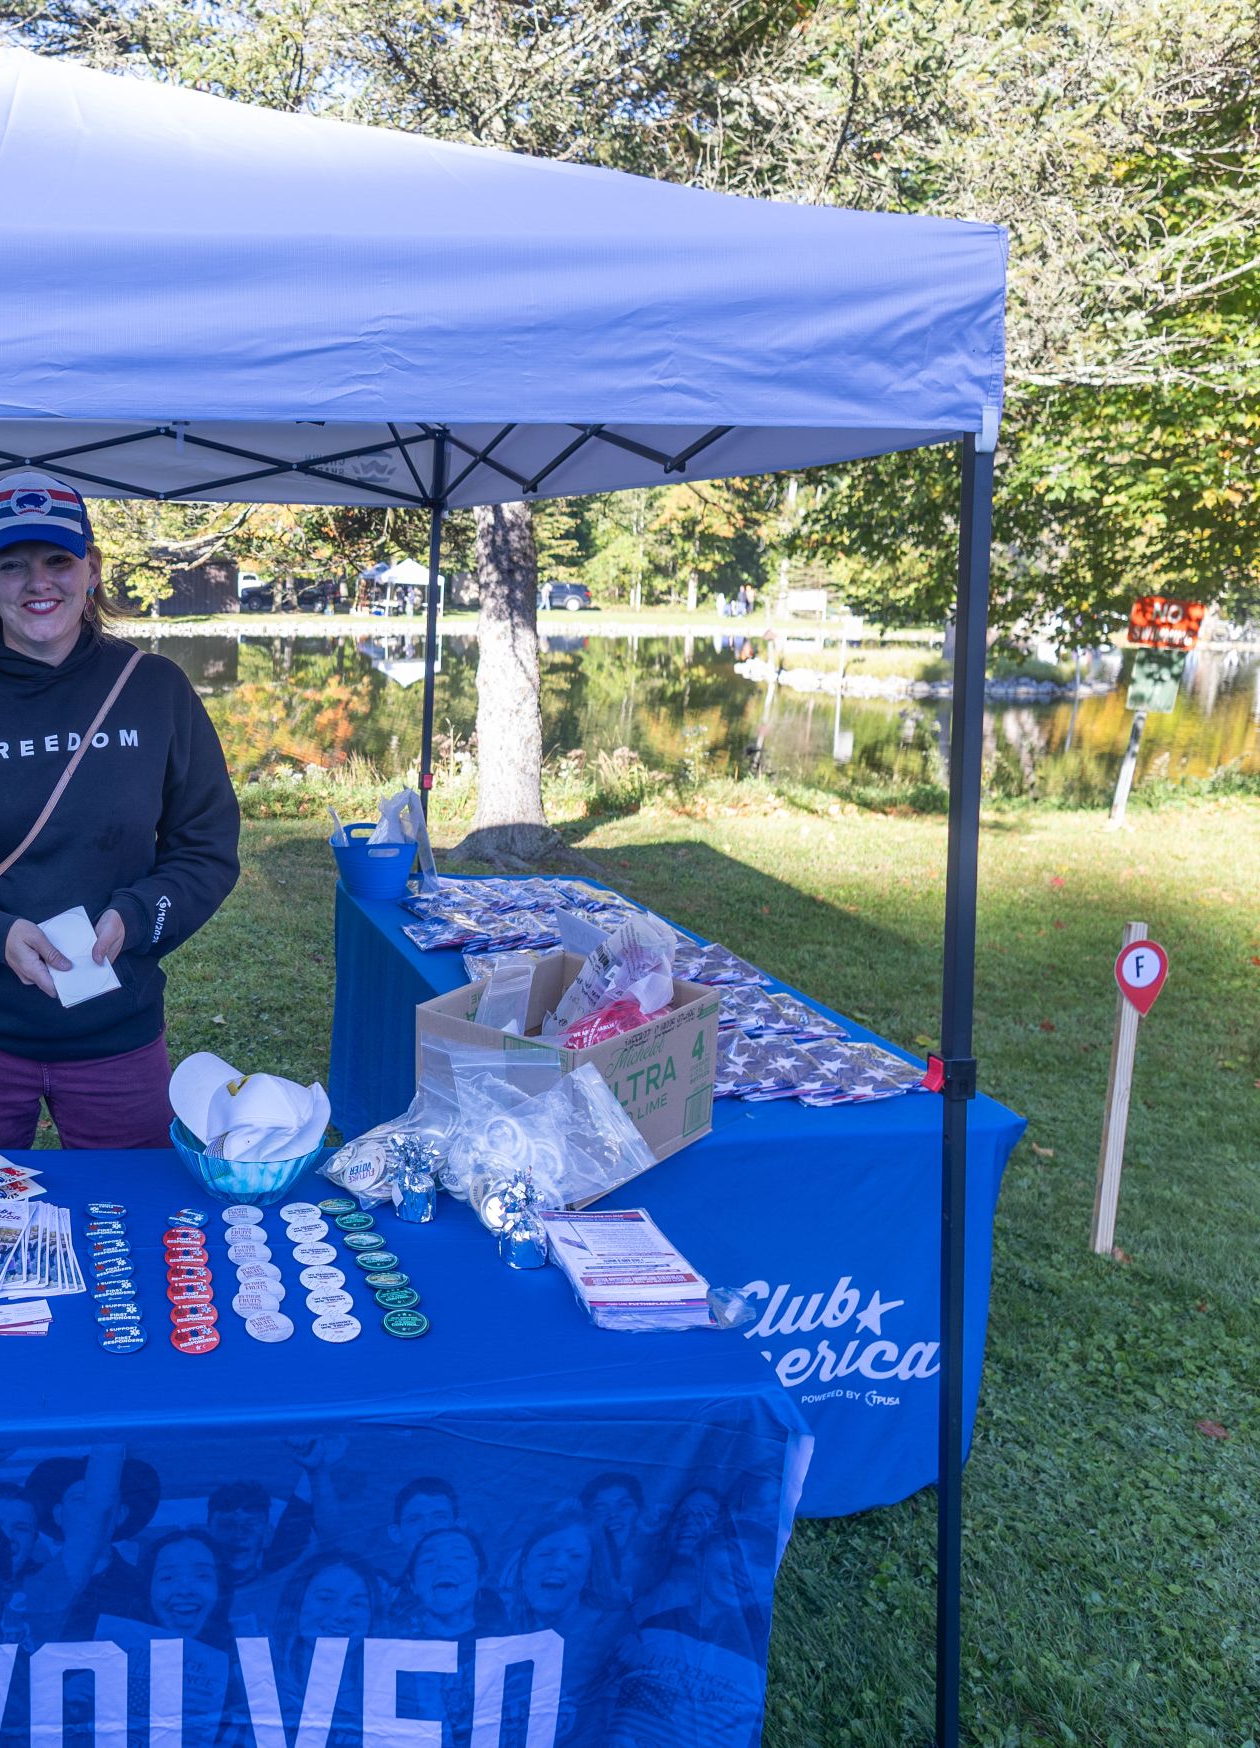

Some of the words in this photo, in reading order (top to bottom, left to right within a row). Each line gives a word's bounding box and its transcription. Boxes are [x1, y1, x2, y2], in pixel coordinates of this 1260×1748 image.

[1153, 602, 1183, 623] NO
[1135, 955, 1145, 979] F
[691, 1030, 705, 1060] 4
[608, 1055, 677, 1108] LTRA
[637, 1093, 668, 1120] LIME
[348, 1167, 375, 1183] FUTURE
[349, 1161, 372, 1176] VOTER
[98, 1257, 122, 1265] SUPPORT
[94, 1290, 135, 1298] RESPONDERS
[740, 1275, 861, 1340] Club
[251, 1319, 276, 1328] FRUITS
[180, 1337, 217, 1348] RESPONDERS
[761, 1340, 941, 1388] erica
[801, 1389, 844, 1404] POWERED
[846, 1391, 861, 1401] BY
[867, 1392, 900, 1406] TPUSA
